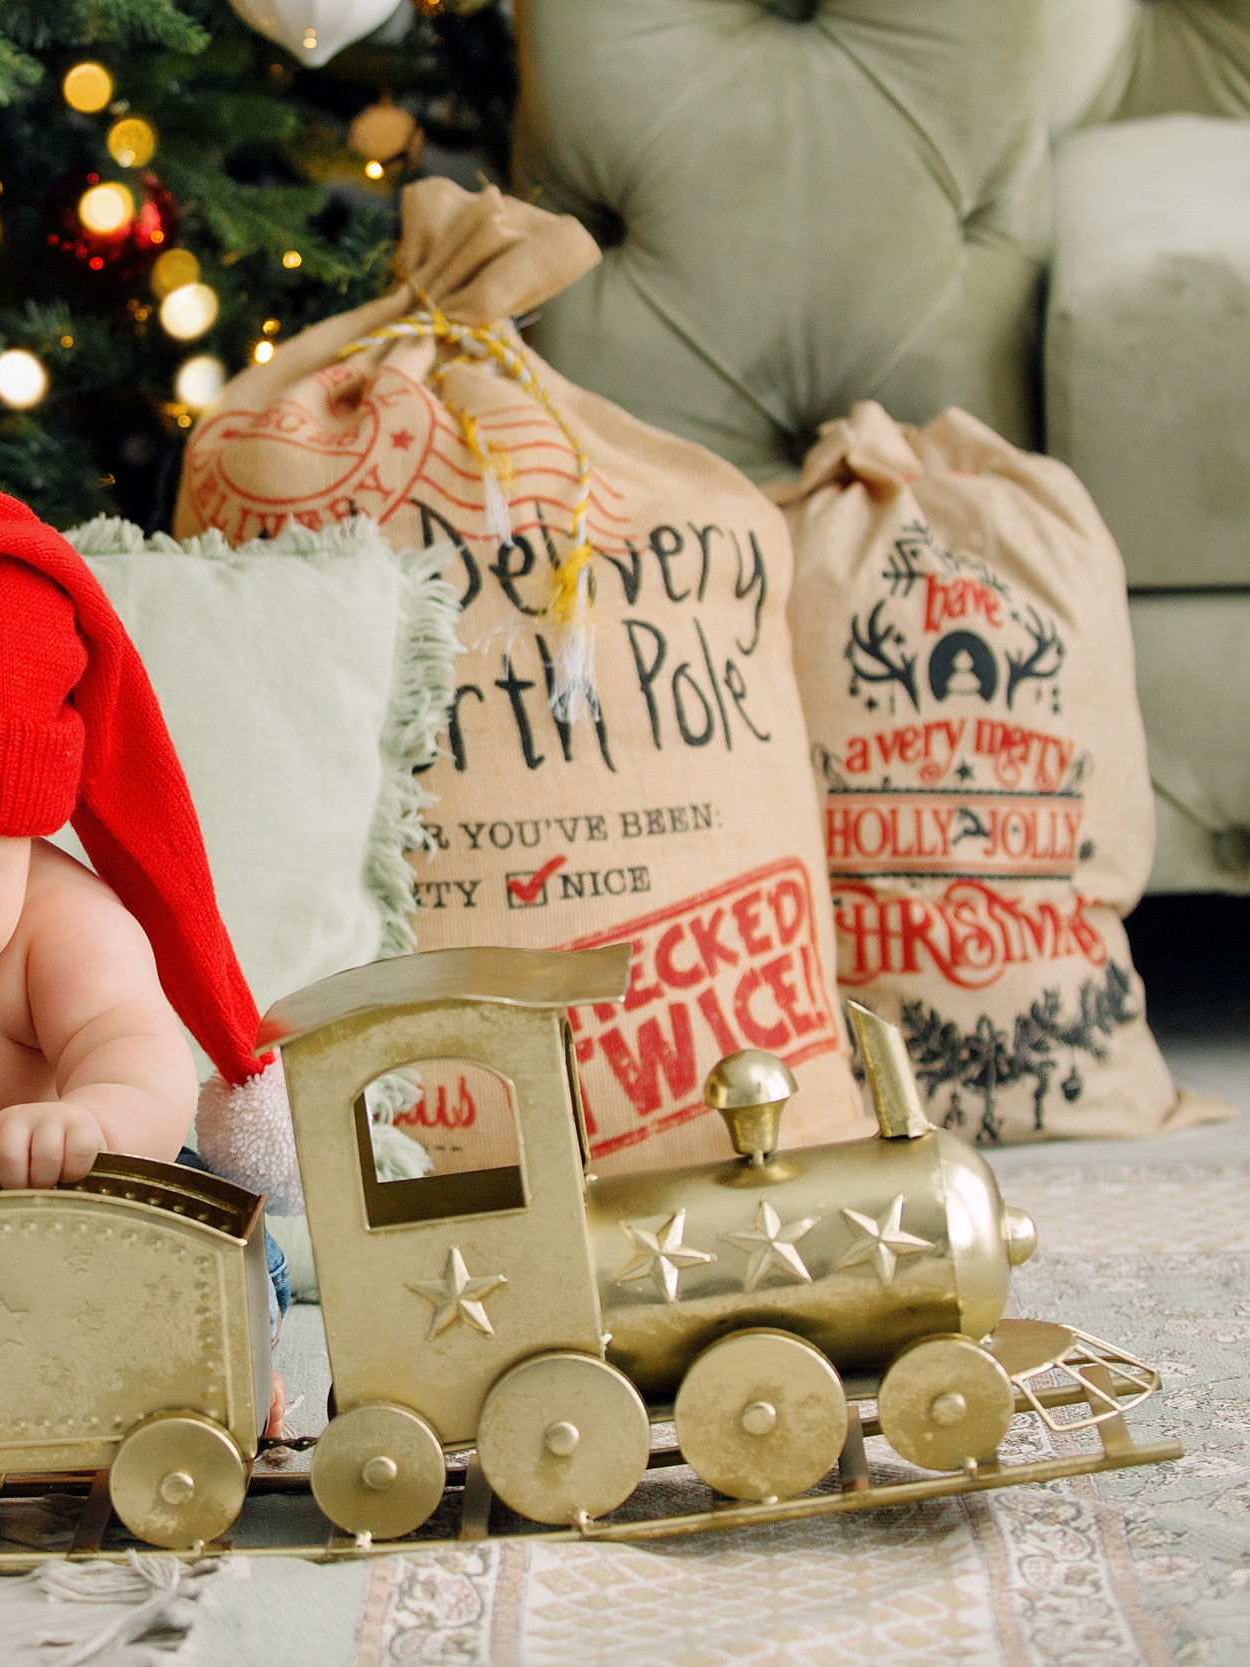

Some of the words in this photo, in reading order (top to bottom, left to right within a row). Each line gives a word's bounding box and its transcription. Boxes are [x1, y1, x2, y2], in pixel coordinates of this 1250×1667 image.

[414, 498, 766, 656] Delvery
[924, 571, 1004, 633] have
[413, 634, 617, 775] rth
[621, 616, 772, 752] Pole
[846, 736, 871, 773] a
[875, 718, 965, 783] very
[975, 717, 1077, 794] merry
[459, 815, 609, 850] YOU'VE
[621, 803, 723, 839] BEEN:
[826, 806, 953, 859] HOLLY
[982, 808, 1085, 862] JOLLY
[561, 866, 651, 900] NICE
